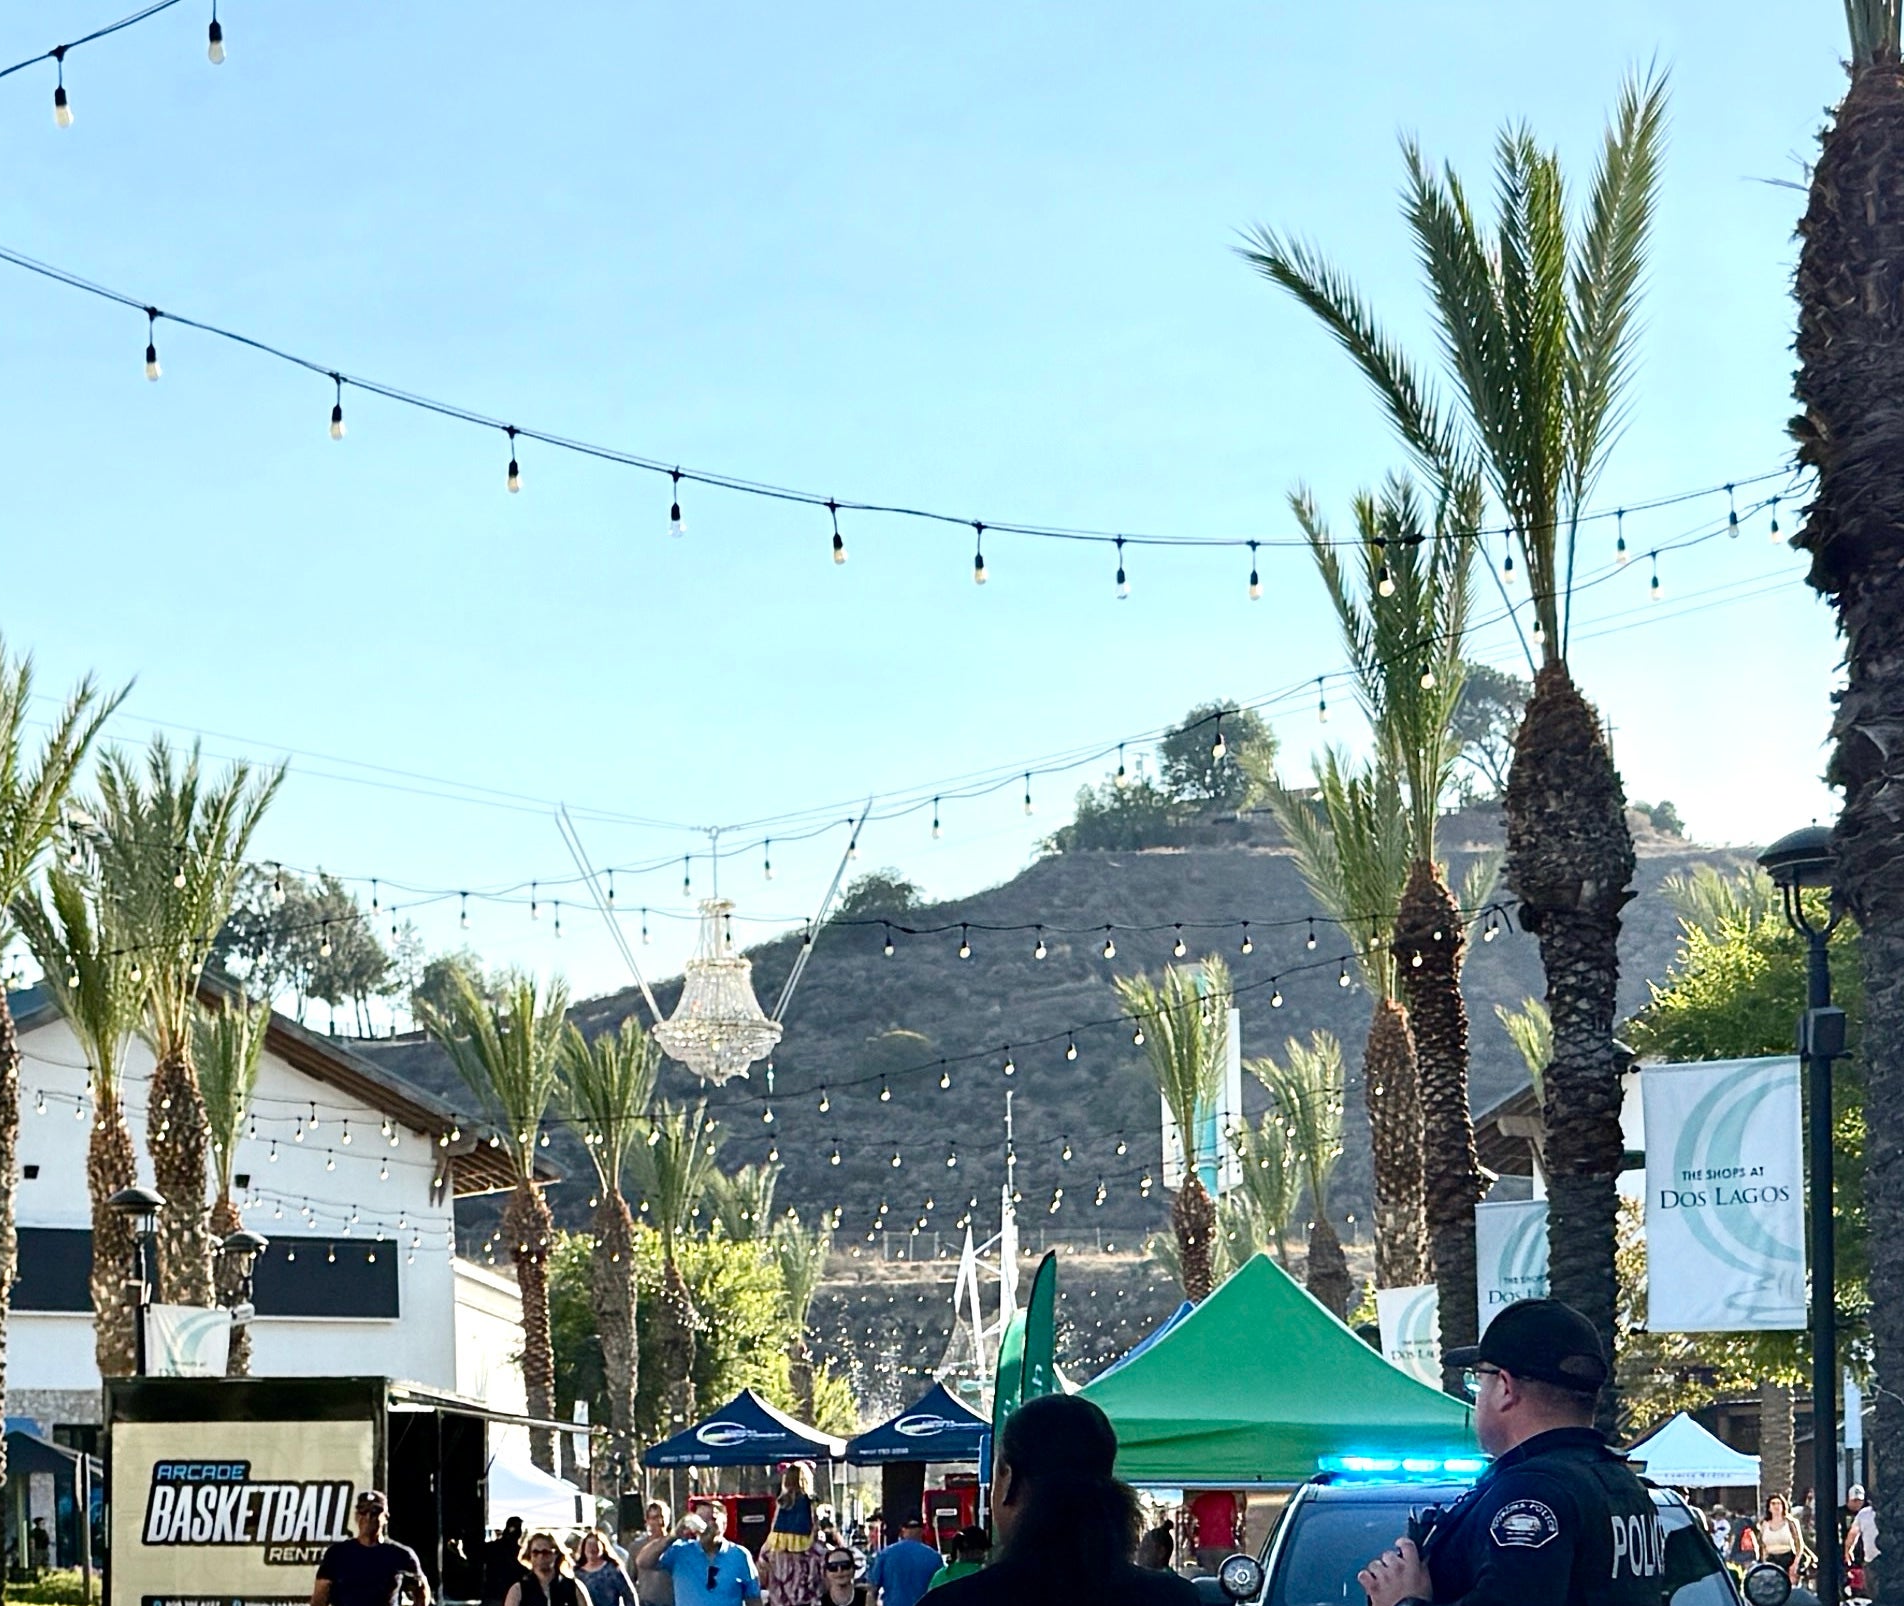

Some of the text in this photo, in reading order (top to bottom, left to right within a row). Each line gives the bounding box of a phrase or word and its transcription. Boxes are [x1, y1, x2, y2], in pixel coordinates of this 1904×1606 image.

[1682, 1166, 1765, 1182] THE SHOPS AT
[157, 1464, 245, 1480] ARCADE
[146, 1483, 352, 1543] BASKETBALL
